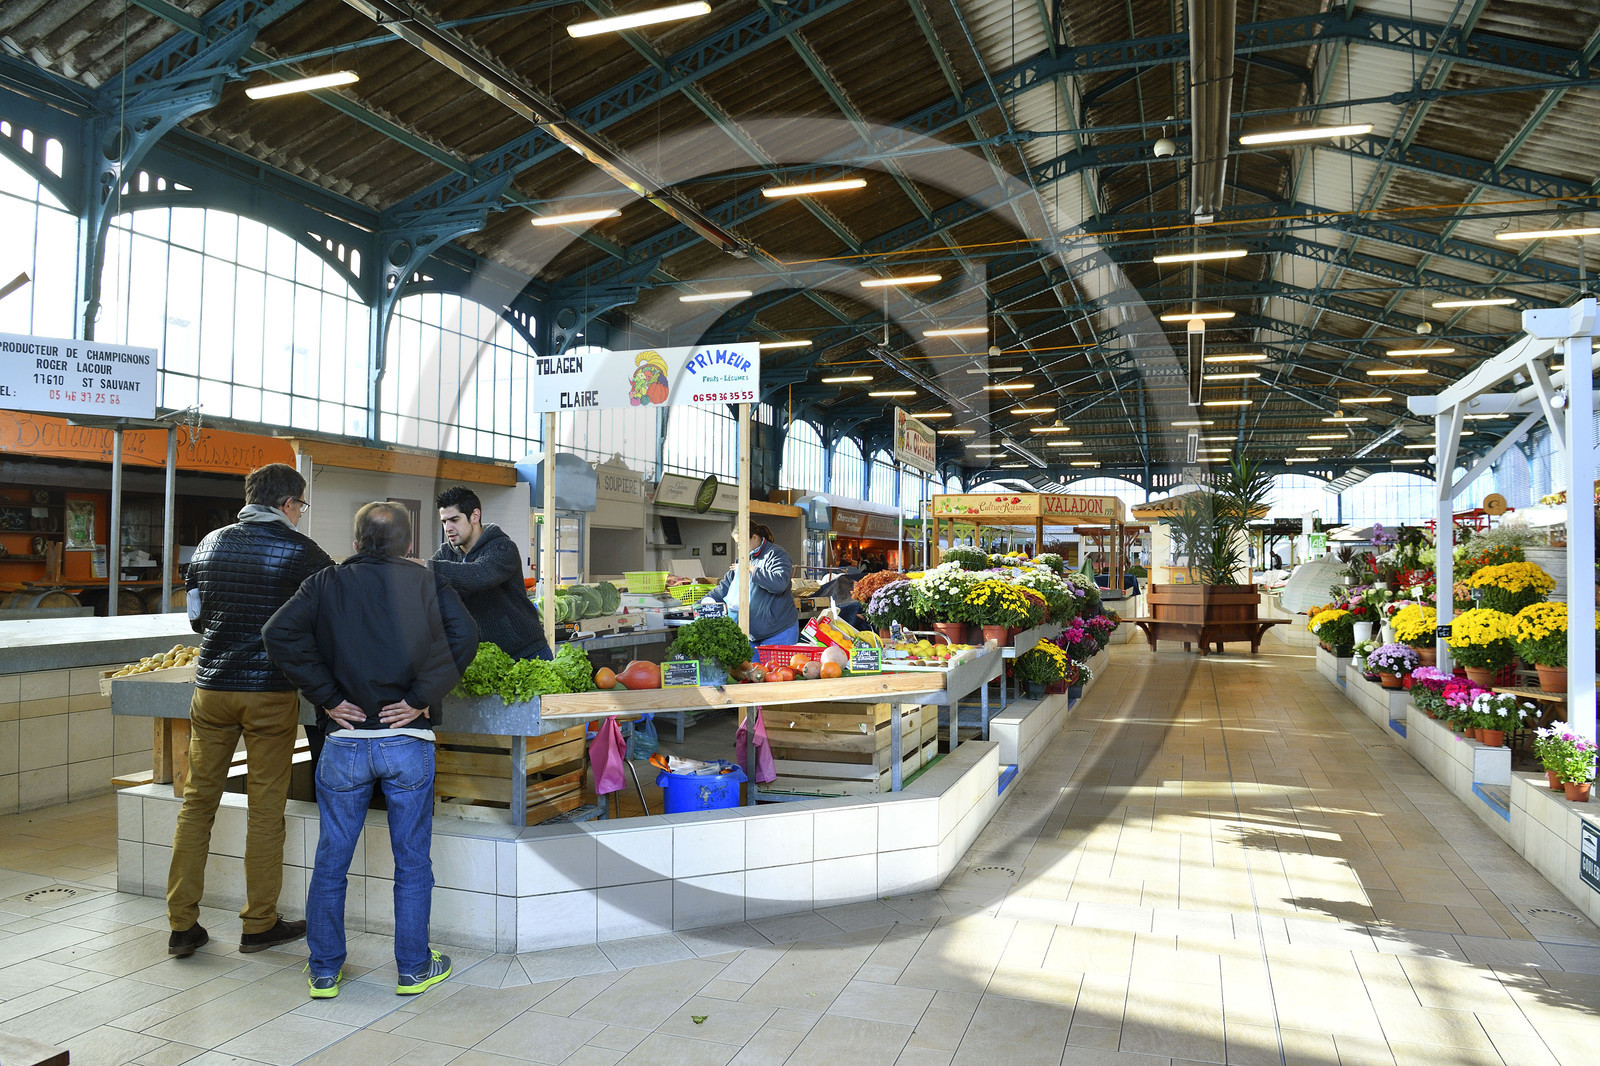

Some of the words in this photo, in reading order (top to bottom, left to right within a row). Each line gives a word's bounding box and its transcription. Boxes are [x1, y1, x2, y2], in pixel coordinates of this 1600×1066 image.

[66, 348, 78, 358] DE
[86, 350, 150, 365] CHAMPIGNONS
[686, 350, 751, 375] PRIMEUR
[36, 359, 67, 371] ROGER
[77, 363, 112, 375] LACOUR
[536, 357, 582, 375] TOLAGEN
[33, 374, 64, 385] 17610
[82, 378, 93, 388] ST
[100, 378, 140, 391] SAUVANT
[0, 386, 16, 396] EL:
[50, 390, 60, 400] 05
[65, 390, 76, 401] 46
[81, 392, 92, 402] 97
[95, 393, 106, 404] 25
[719, 393, 727, 401] 36
[730, 392, 739, 400] 35
[742, 391, 753, 400] 55
[596, 474, 601, 489] A
[1045, 497, 1103, 513] VALADON
